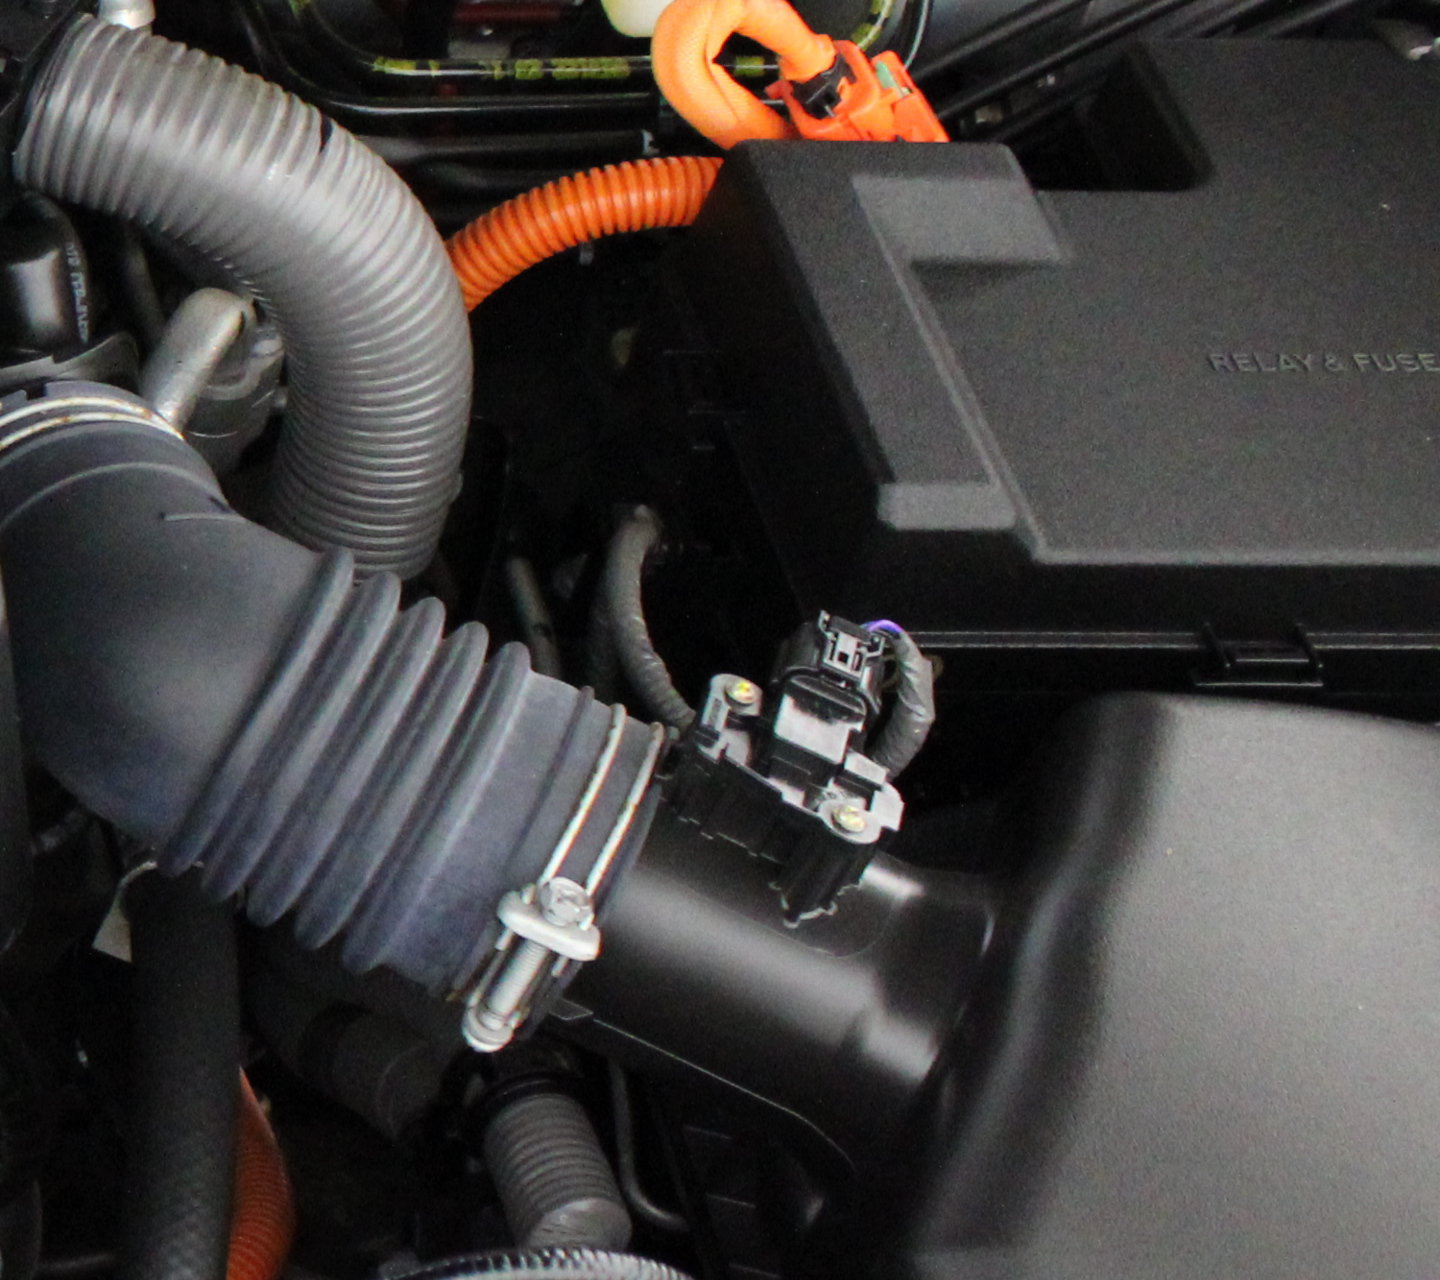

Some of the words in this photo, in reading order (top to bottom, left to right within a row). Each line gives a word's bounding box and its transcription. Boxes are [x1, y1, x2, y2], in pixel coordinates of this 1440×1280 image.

[1206, 353, 1312, 372] RELAY
[1325, 353, 1344, 371] &
[1351, 353, 1440, 371] FUSE
